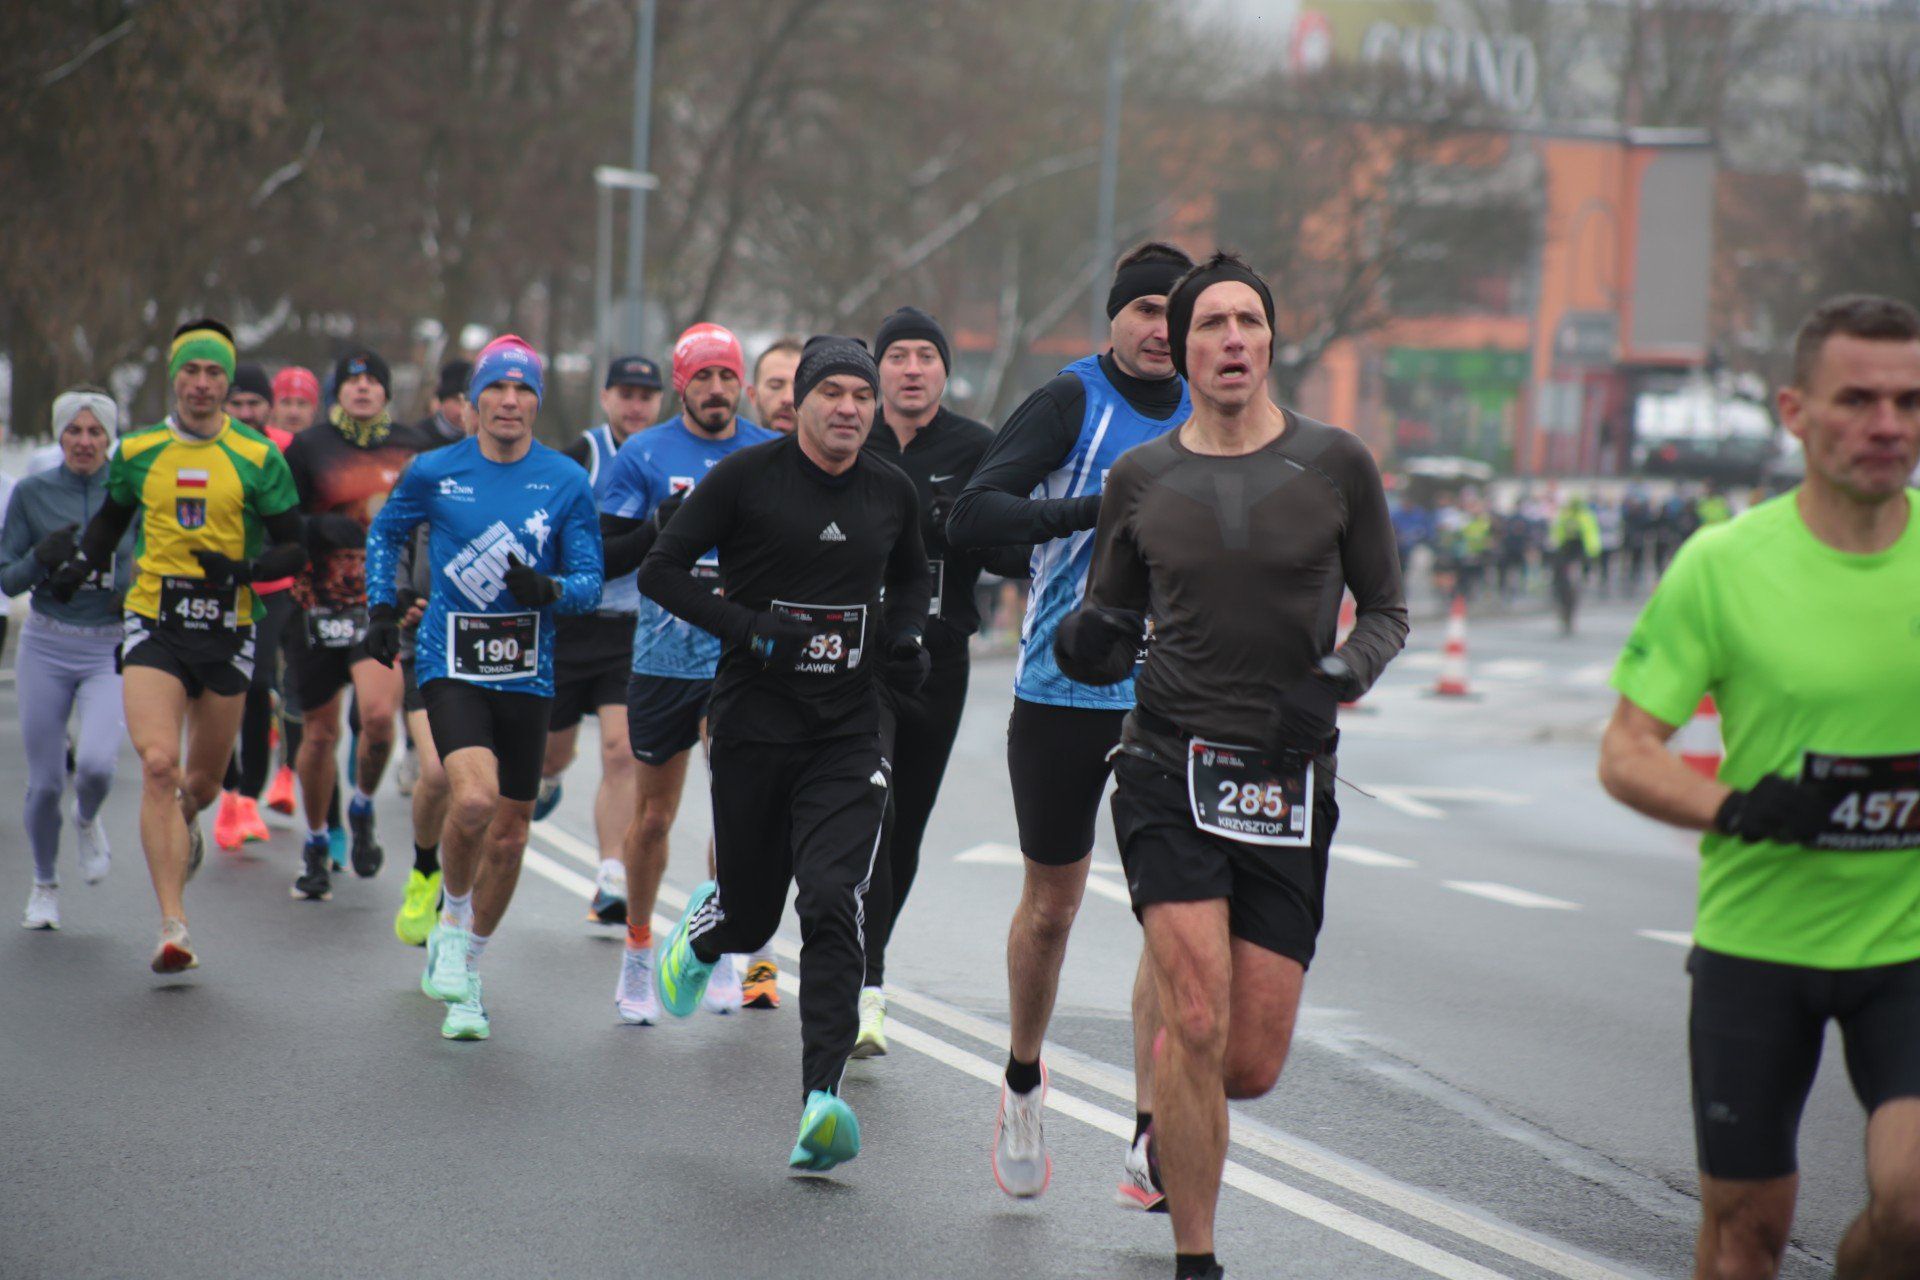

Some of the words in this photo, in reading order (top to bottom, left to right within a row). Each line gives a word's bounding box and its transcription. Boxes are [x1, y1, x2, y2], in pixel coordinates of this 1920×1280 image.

[175, 597, 220, 620] 455
[473, 638, 519, 662] 190
[802, 634, 842, 660] 53
[479, 664, 514, 673] TOMASZ
[1218, 780, 1283, 818] 285
[1830, 791, 1919, 830] 457
[1218, 816, 1284, 834] KRZYSZTOF
